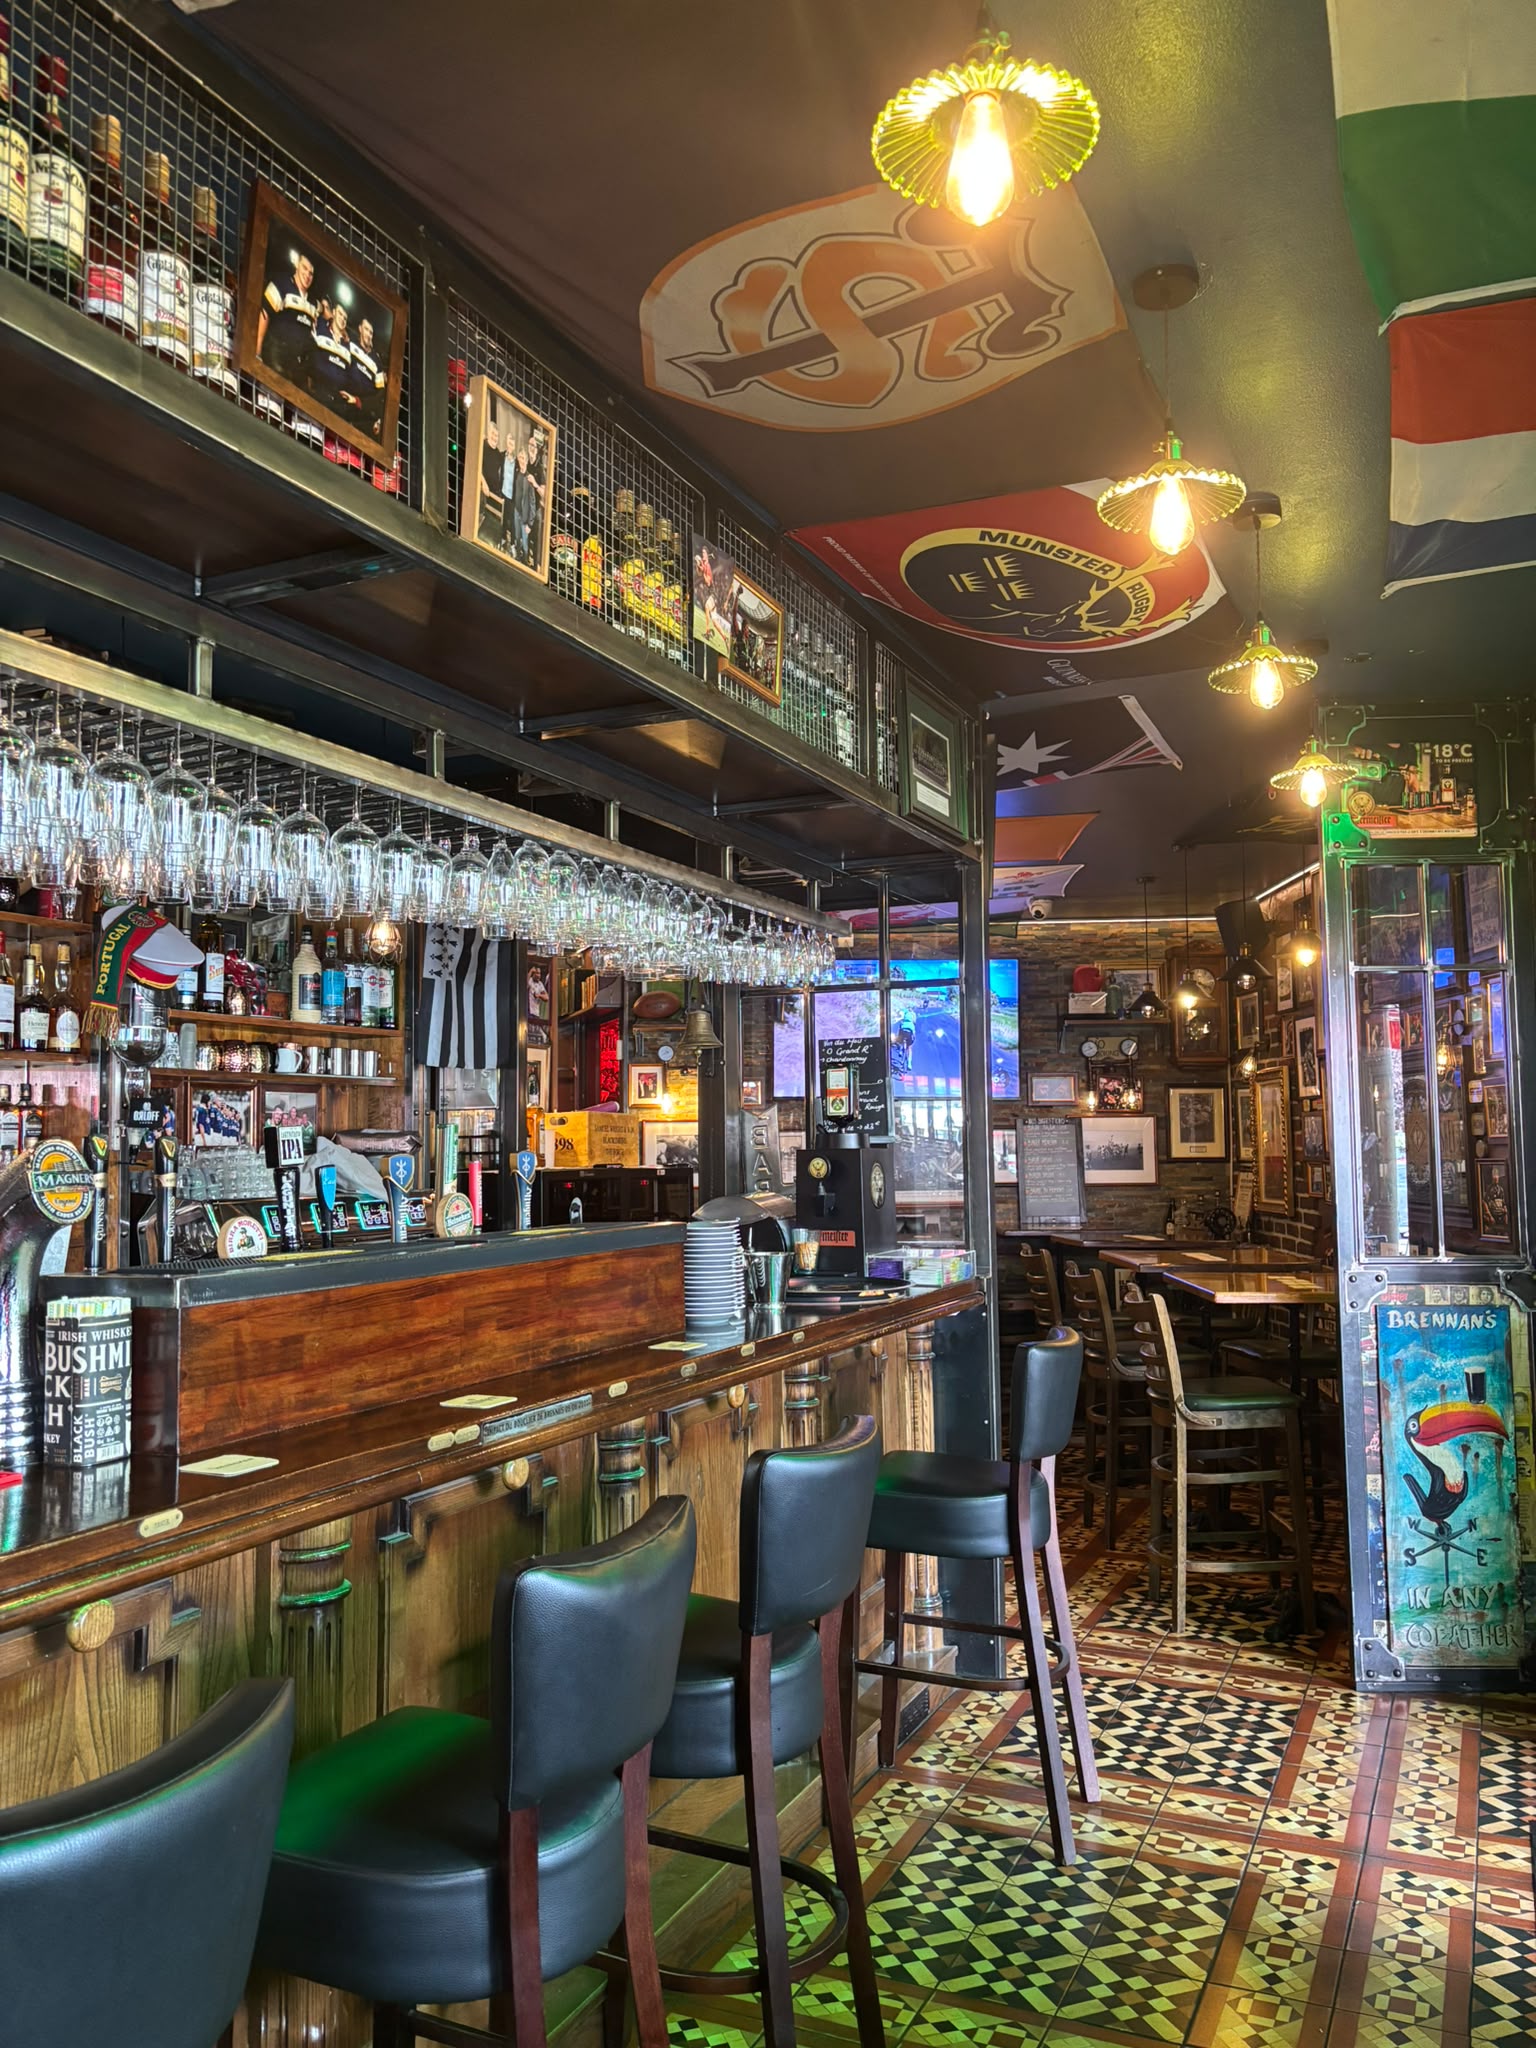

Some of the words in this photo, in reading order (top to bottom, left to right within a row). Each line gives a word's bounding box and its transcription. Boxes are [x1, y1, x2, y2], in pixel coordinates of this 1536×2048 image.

[979, 529, 1114, 576] MUNSTER
[1126, 581, 1152, 623] RUGBY
[96, 923, 131, 996] PORTUGAL
[281, 1138, 303, 1160] IPA
[36, 1172, 94, 1188] MAGNERS
[95, 1197, 106, 1241] GUINNESS
[166, 1196, 177, 1238] GUINNESS
[280, 1174, 297, 1239] LAGUNITAS
[445, 1210, 472, 1227] Heineken
[229, 1226, 239, 1254] BIRRA
[237, 1219, 264, 1241] MORETTI
[58, 1331, 88, 1343] IRISH
[1387, 1309, 1498, 1331] BRENNAN'S
[73, 1414, 84, 1463] BLACK
[84, 1417, 96, 1458] BUSH
[1407, 1516, 1422, 1531] W
[1467, 1517, 1478, 1533] N
[1403, 1548, 1418, 1567] S
[1476, 1548, 1488, 1567] E
[1407, 1585, 1431, 1610] IN
[1442, 1582, 1498, 1610] ANY
